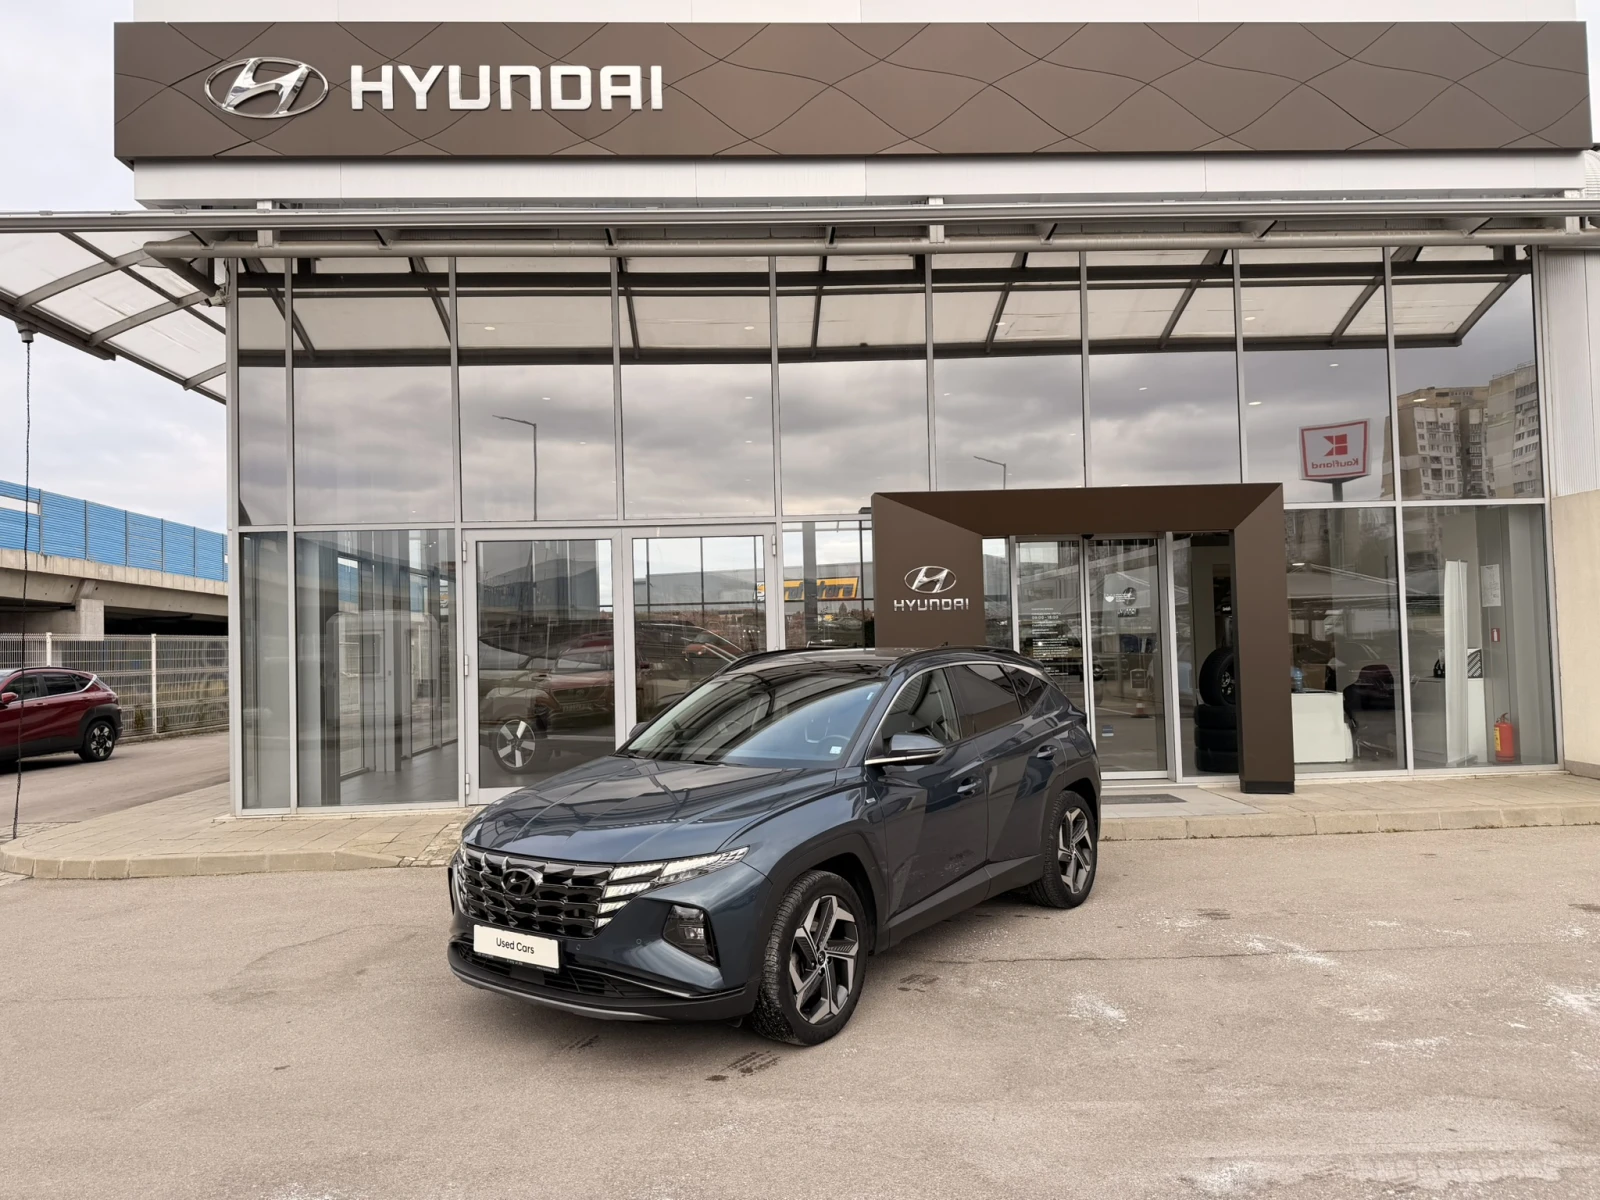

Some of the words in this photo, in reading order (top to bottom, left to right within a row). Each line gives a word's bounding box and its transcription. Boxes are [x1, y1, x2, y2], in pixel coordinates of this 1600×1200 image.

[351, 65, 663, 110] HYUNDAI
[893, 598, 969, 611] HYUNDAI
[496, 937, 515, 950] Used
[516, 942, 535, 954] Cars
